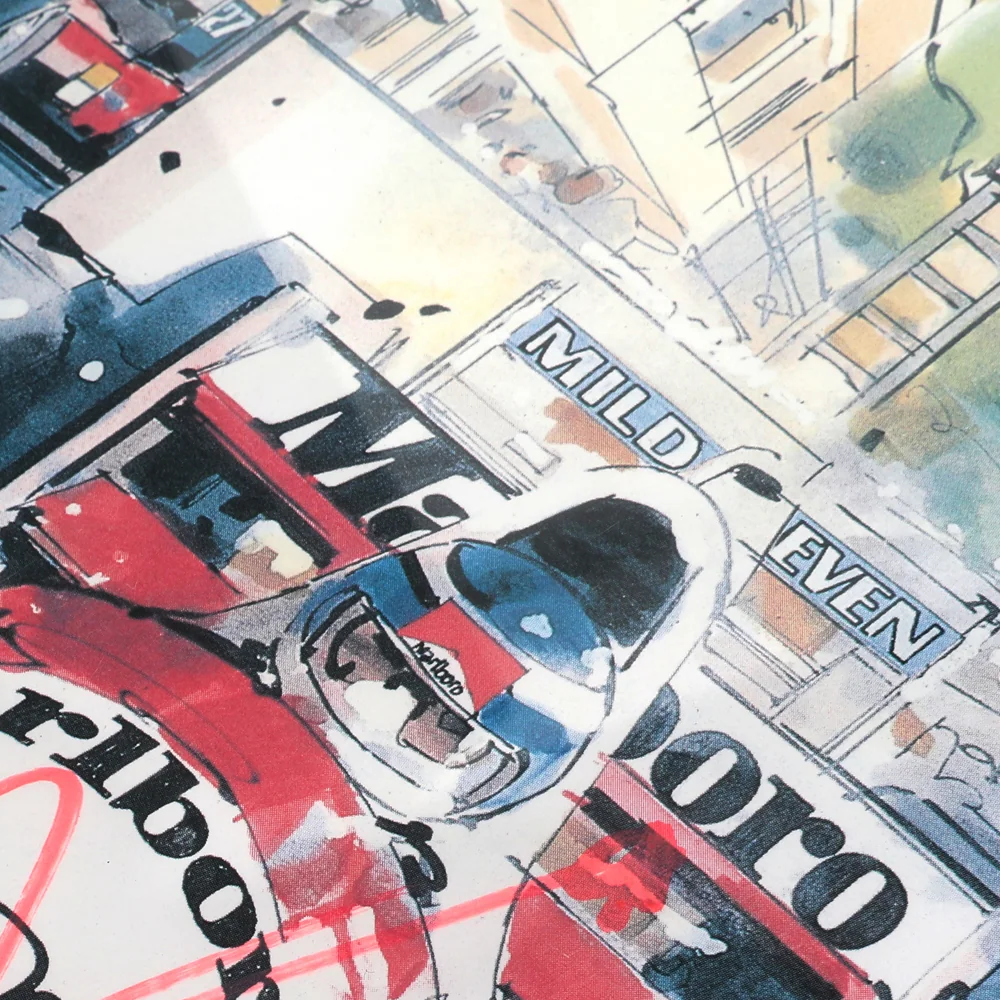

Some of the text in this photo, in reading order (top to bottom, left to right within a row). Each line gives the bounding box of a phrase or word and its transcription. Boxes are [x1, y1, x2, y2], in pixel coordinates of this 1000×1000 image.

[516, 316, 946, 666] MILD EVEN
[411, 641, 464, 696] Marlboro
